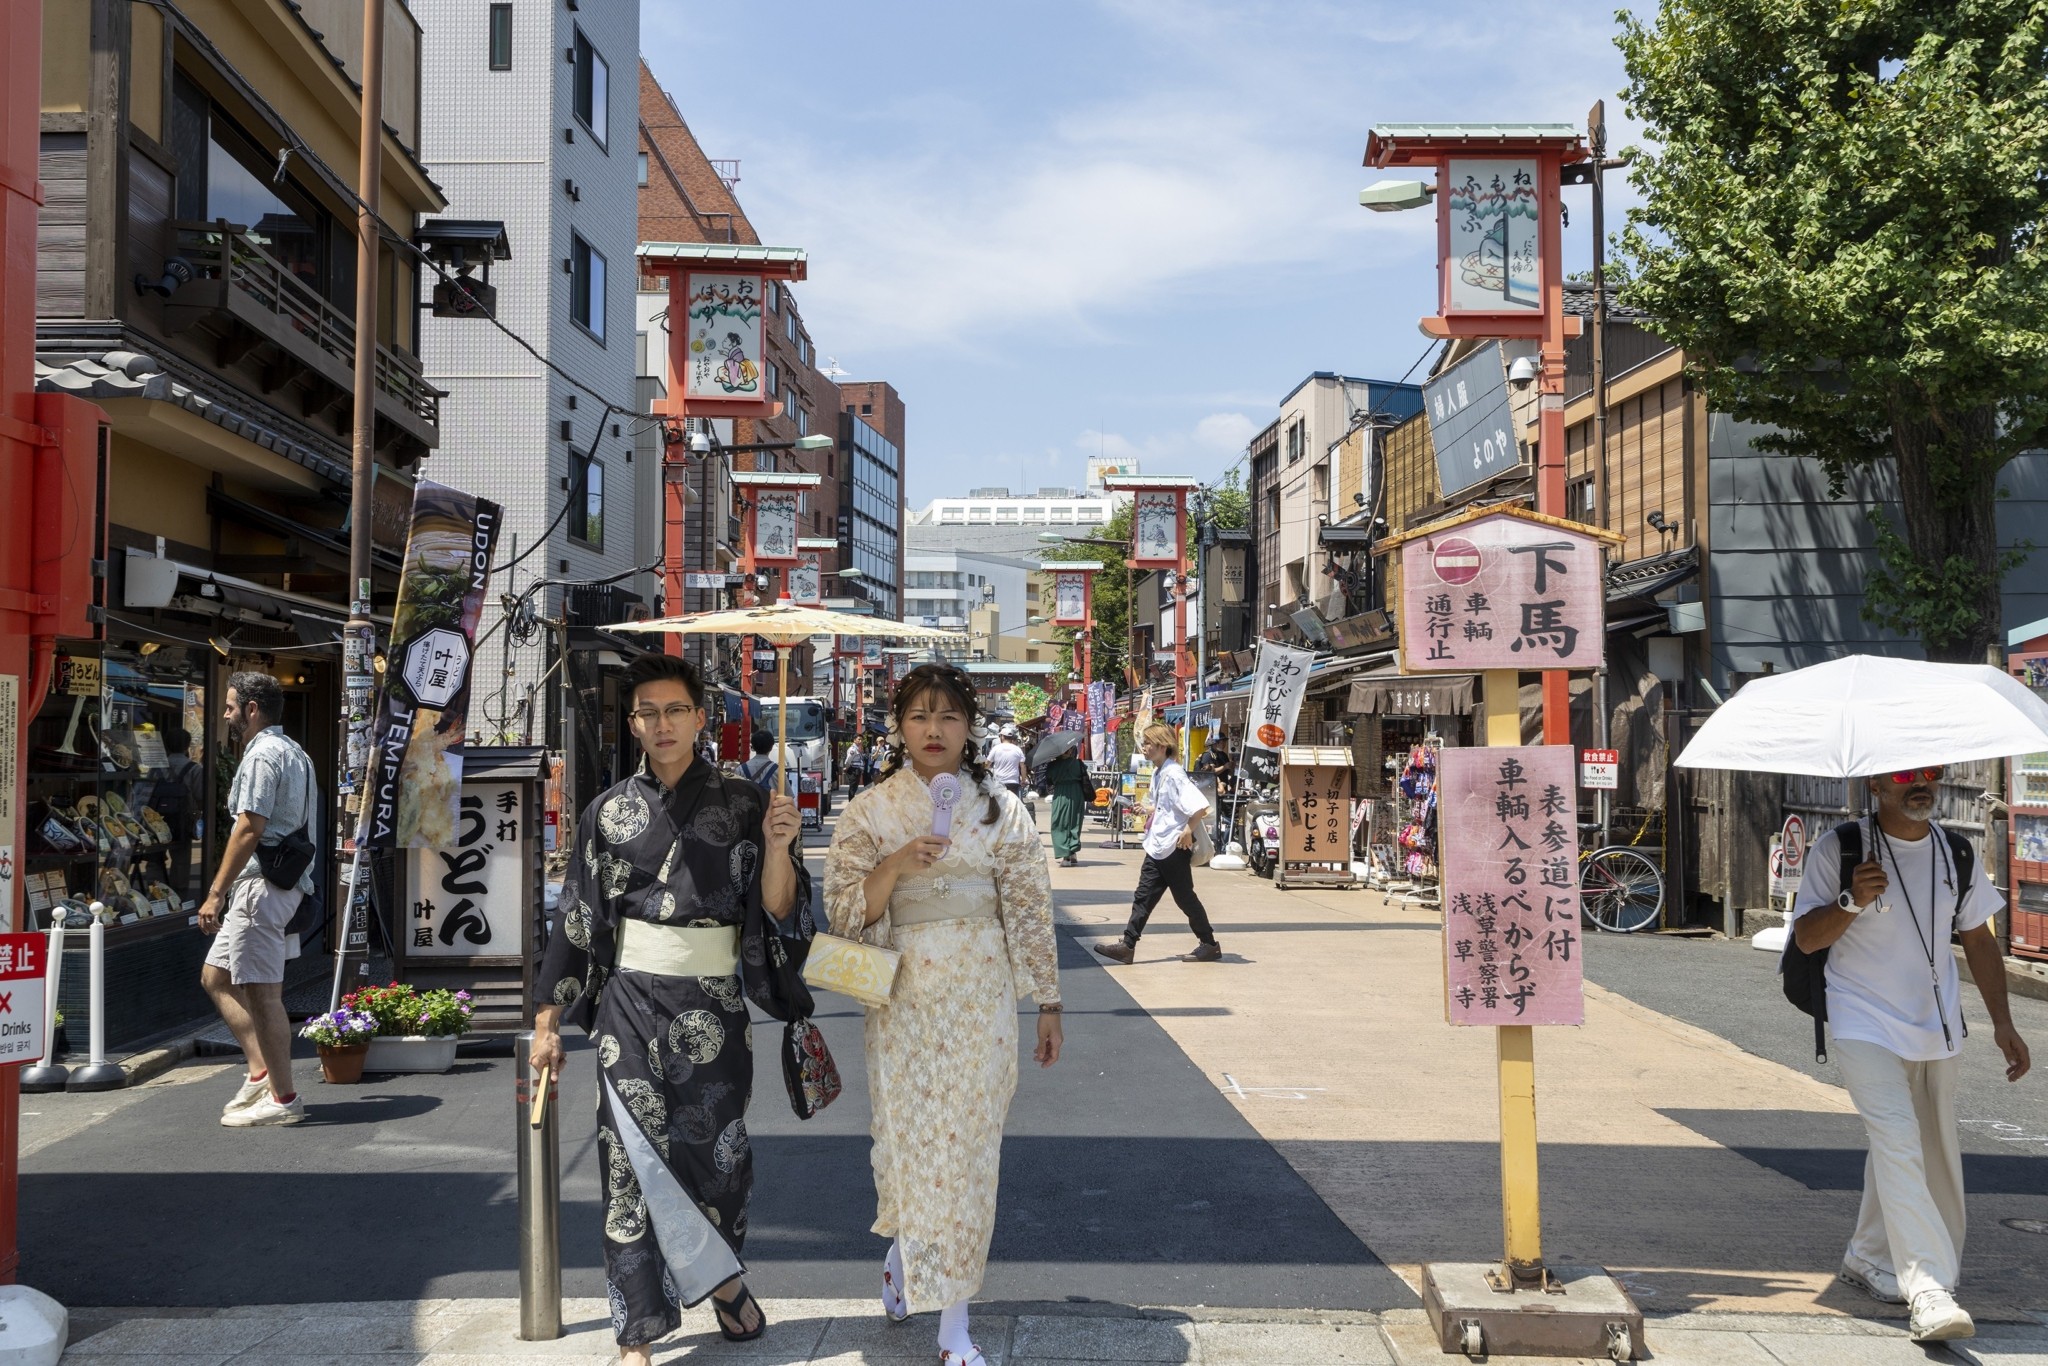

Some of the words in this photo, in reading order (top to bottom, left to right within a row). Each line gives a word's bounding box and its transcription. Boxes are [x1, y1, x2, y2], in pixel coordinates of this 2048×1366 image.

[1490, 174, 1507, 210] もの
[1513, 167, 1532, 204] ねた
[1523, 239, 1533, 273] にたもの
[1434, 380, 1469, 422] 婦人服
[1473, 428, 1507, 470] よのや
[471, 513, 493, 590] UDON
[1507, 541, 1580, 659] 下馬
[1424, 593, 1456, 661] 通行止
[428, 648, 454, 689] 叶屋
[1263, 660, 1301, 724] わらび餅
[374, 710, 413, 839] TEMPURA
[1304, 768, 1314, 787] 浅草
[1583, 752, 1614, 762] 飲食禁止
[496, 790, 519, 842] 手打
[1302, 790, 1318, 852] おじま
[1326, 789, 1340, 844] 切子の店
[438, 795, 494, 947] うどん
[1538, 784, 1577, 962] 表参道に付
[1783, 868, 1802, 878] 飲食禁止
[413, 899, 436, 948] 叶屋
[0, 943, 35, 974] 禁止
[1451, 892, 1477, 1011] 浅草寺
[1475, 892, 1500, 1010] 浅草警察署
[1, 1021, 32, 1037] Drinks
[16, 1040, 31, 1052] 금지
